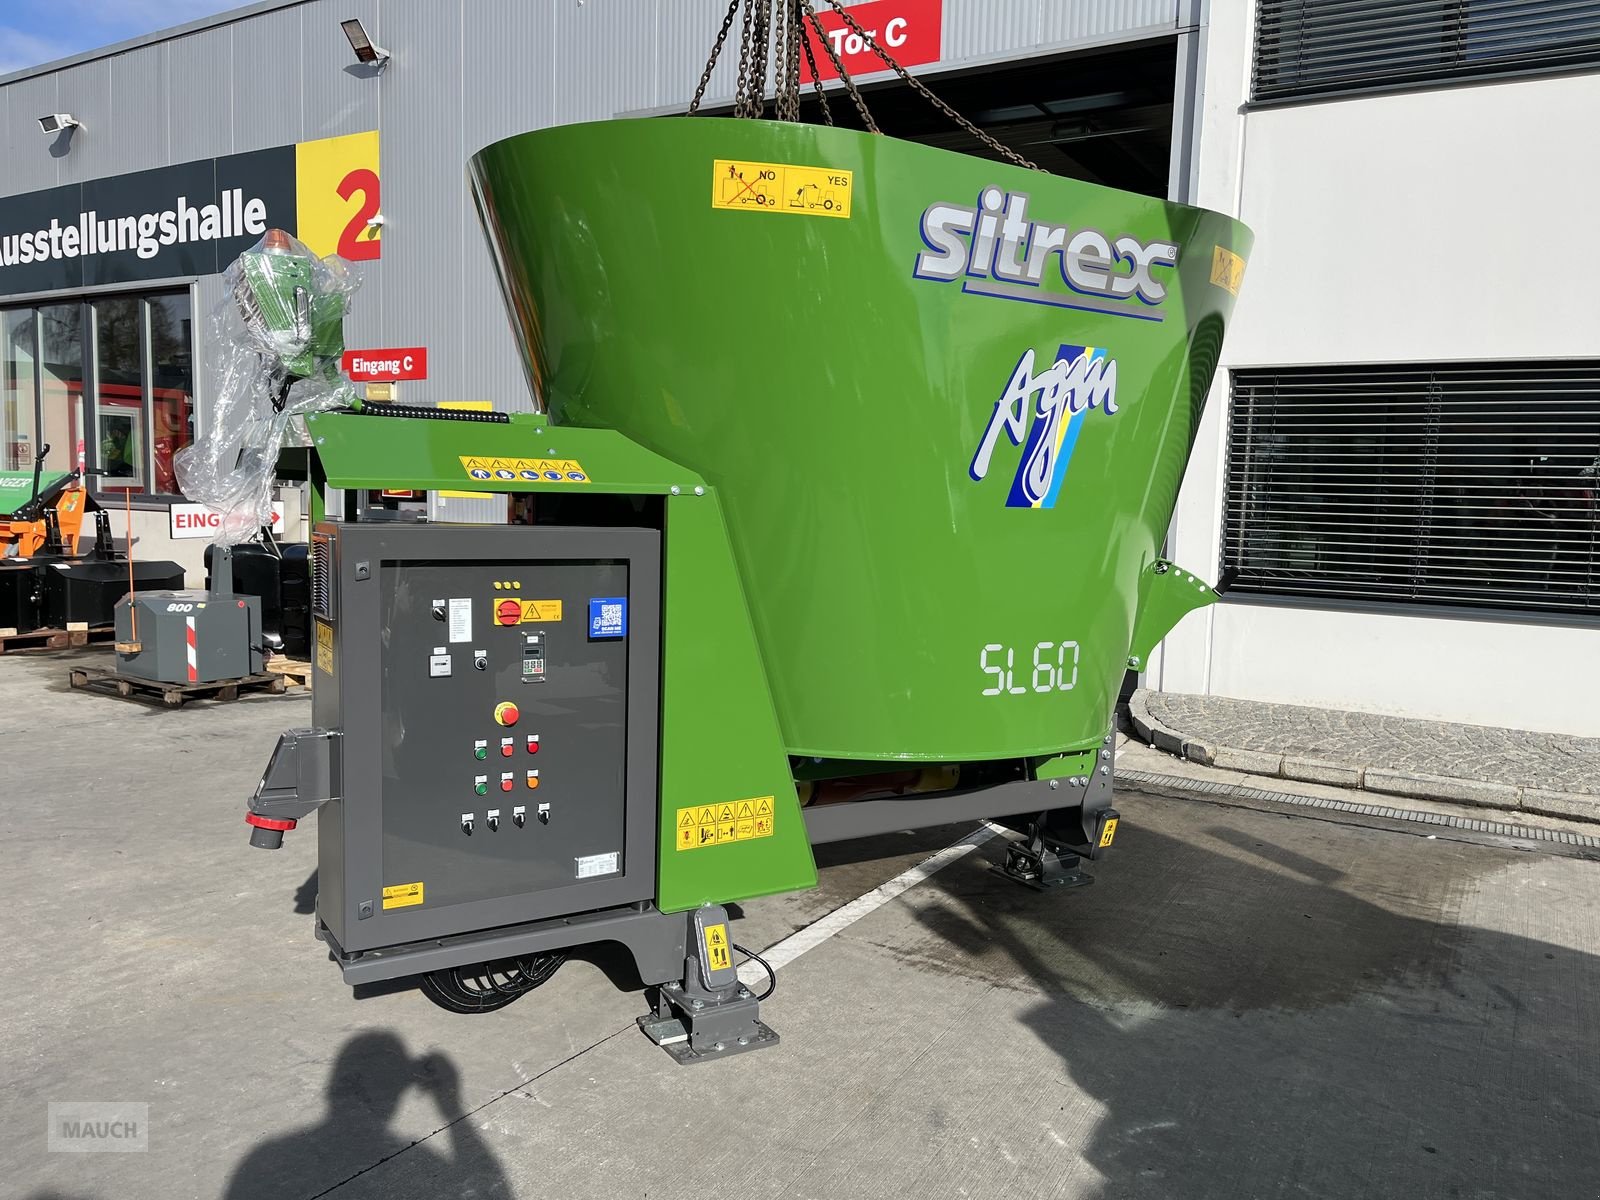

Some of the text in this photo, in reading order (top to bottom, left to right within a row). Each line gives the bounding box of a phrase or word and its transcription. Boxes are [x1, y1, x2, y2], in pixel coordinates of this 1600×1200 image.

[828, 17, 908, 57] Tor C
[759, 170, 776, 181] NO
[827, 175, 848, 187] YES
[335, 168, 381, 262] 2
[912, 184, 1180, 305] sitrex
[352, 355, 414, 376] Eingang C
[968, 347, 1120, 502] Agm
[175, 512, 236, 529] EING
[166, 603, 193, 613] 800
[980, 640, 1080, 696] SL 60
